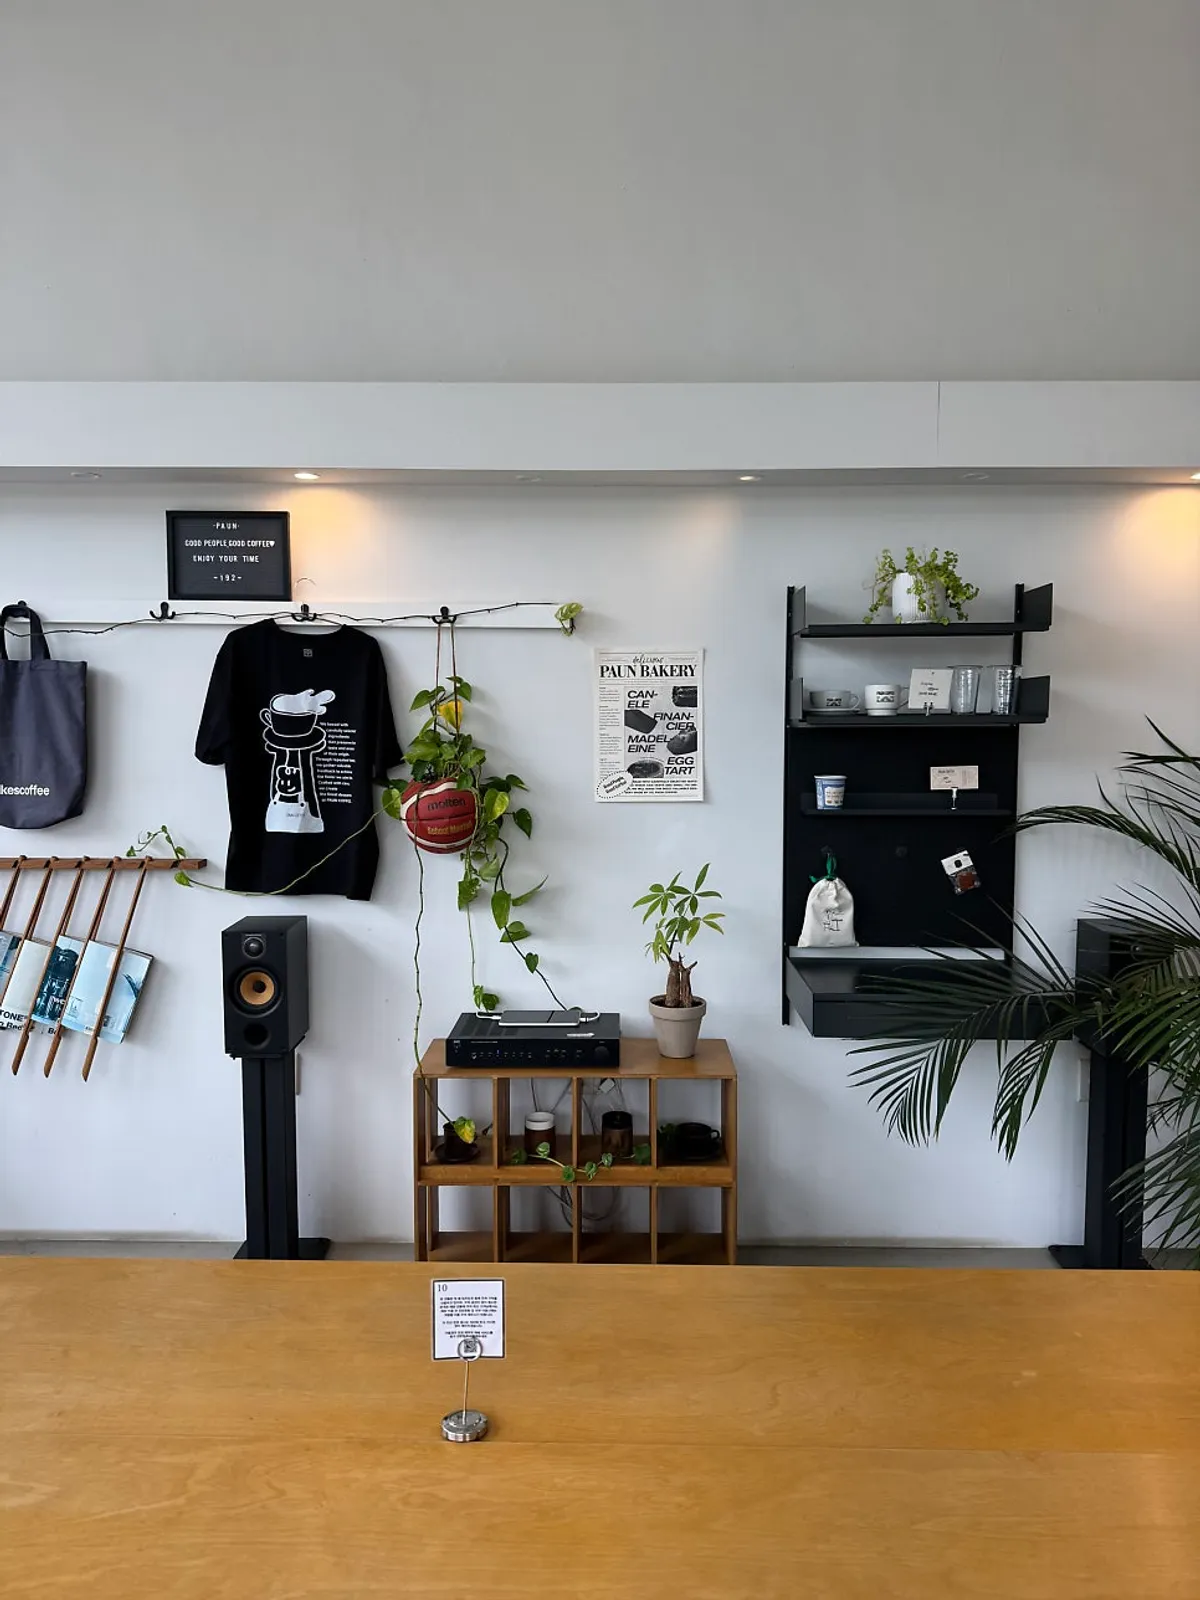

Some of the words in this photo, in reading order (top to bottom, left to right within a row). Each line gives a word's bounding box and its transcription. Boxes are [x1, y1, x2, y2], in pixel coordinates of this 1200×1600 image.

[184, 539, 203, 547] GOOD
[192, 555, 215, 563] ENJOY
[218, 555, 238, 563] YOUR
[242, 555, 260, 563] TIME
[600, 664, 637, 678] PAUN
[640, 664, 697, 678] BAKERY
[627, 690, 659, 699] CAN-
[627, 700, 650, 709] ELE
[653, 712, 695, 721] FINAN-
[665, 721, 695, 731] CIER
[627, 744, 656, 753] EINE
[667, 756, 695, 765] EGG
[664, 766, 696, 775] TART
[427, 798, 467, 812] molten
[437, 1283, 448, 1292] 10
